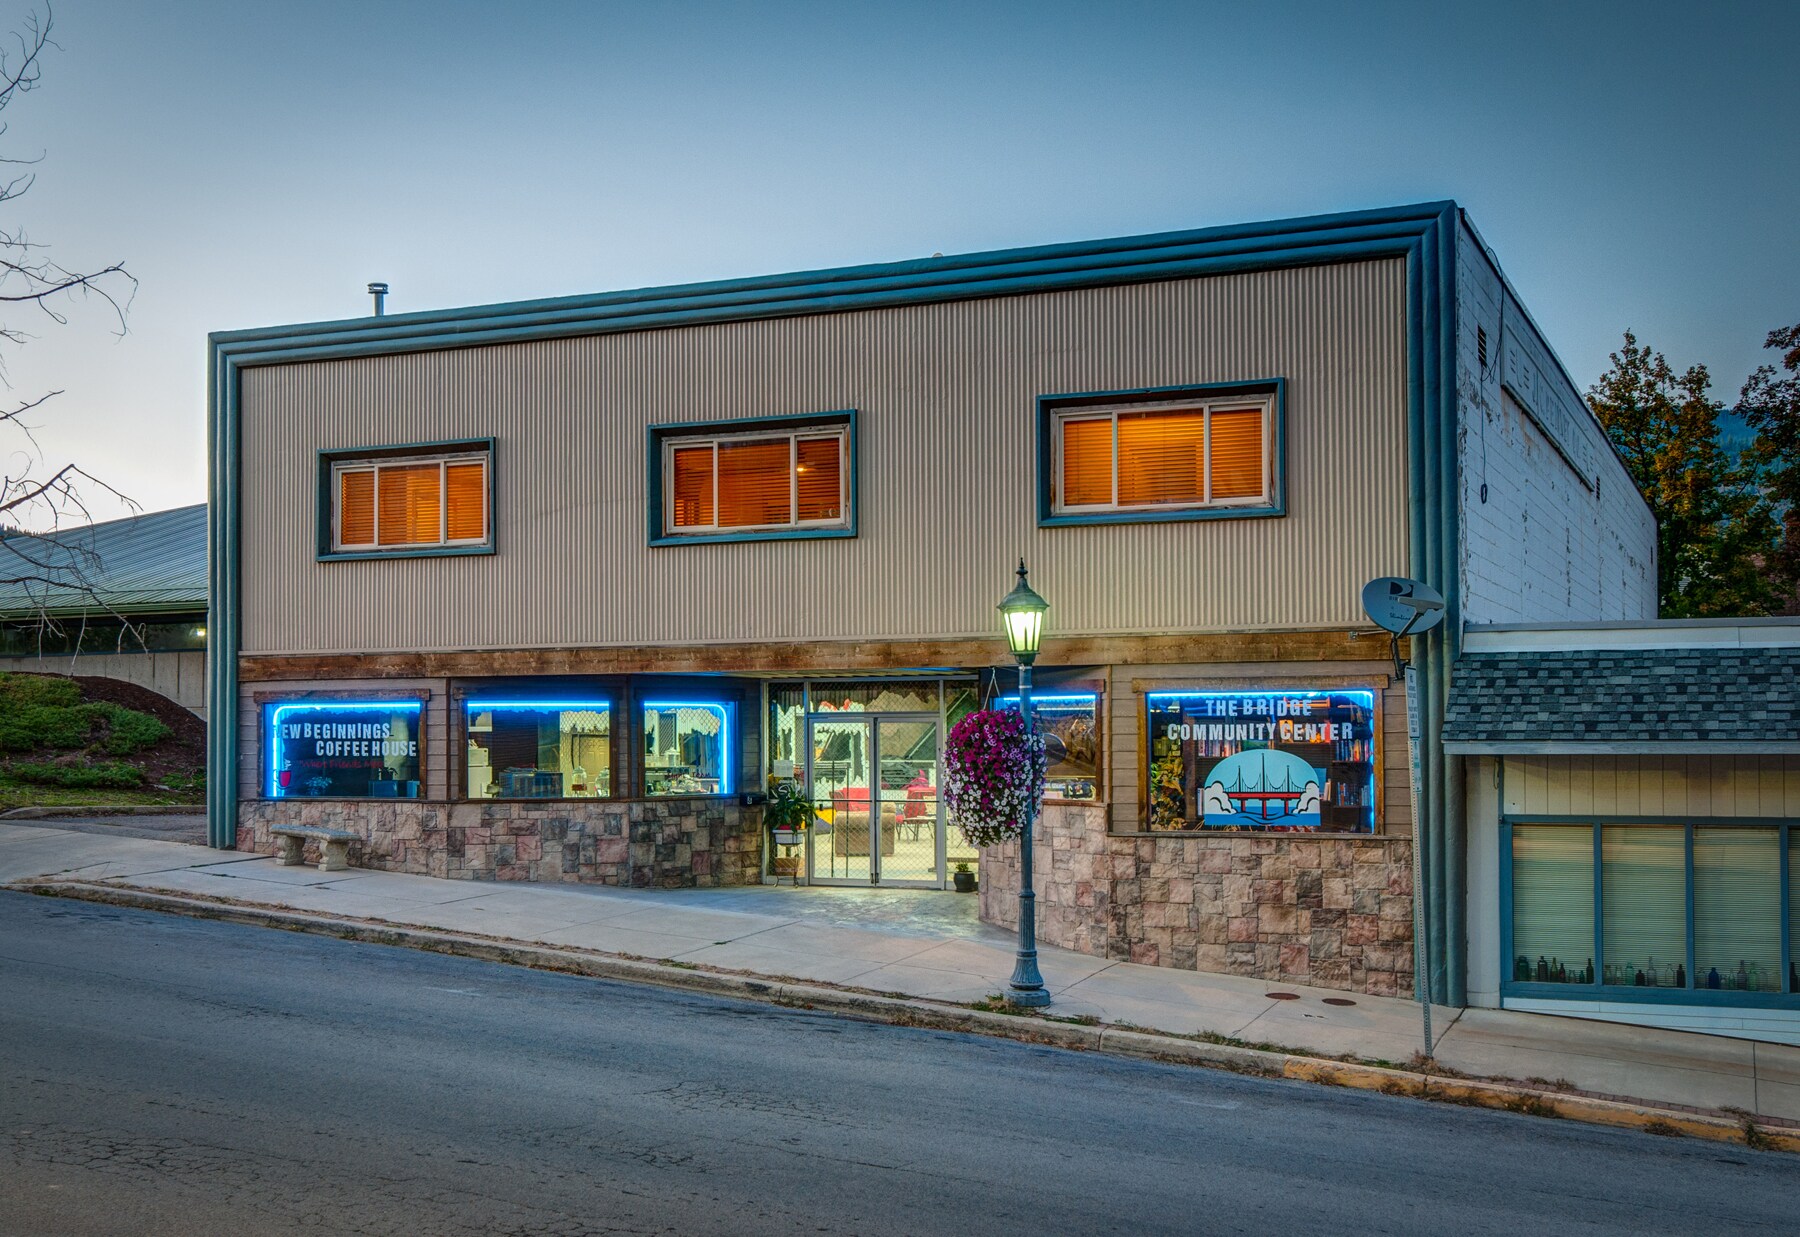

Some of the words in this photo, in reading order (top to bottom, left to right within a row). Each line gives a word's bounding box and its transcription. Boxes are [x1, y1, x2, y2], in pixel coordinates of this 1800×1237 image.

[1205, 699, 1238, 717] THE
[1242, 698, 1312, 717] BRIDGE
[277, 723, 301, 739] EW
[303, 722, 390, 740] BEGINNINGS
[1167, 723, 1276, 741] COMMUNITY
[1279, 722, 1353, 741] CENTER
[316, 740, 369, 757] COFFEE
[371, 740, 417, 757] HOUSE
